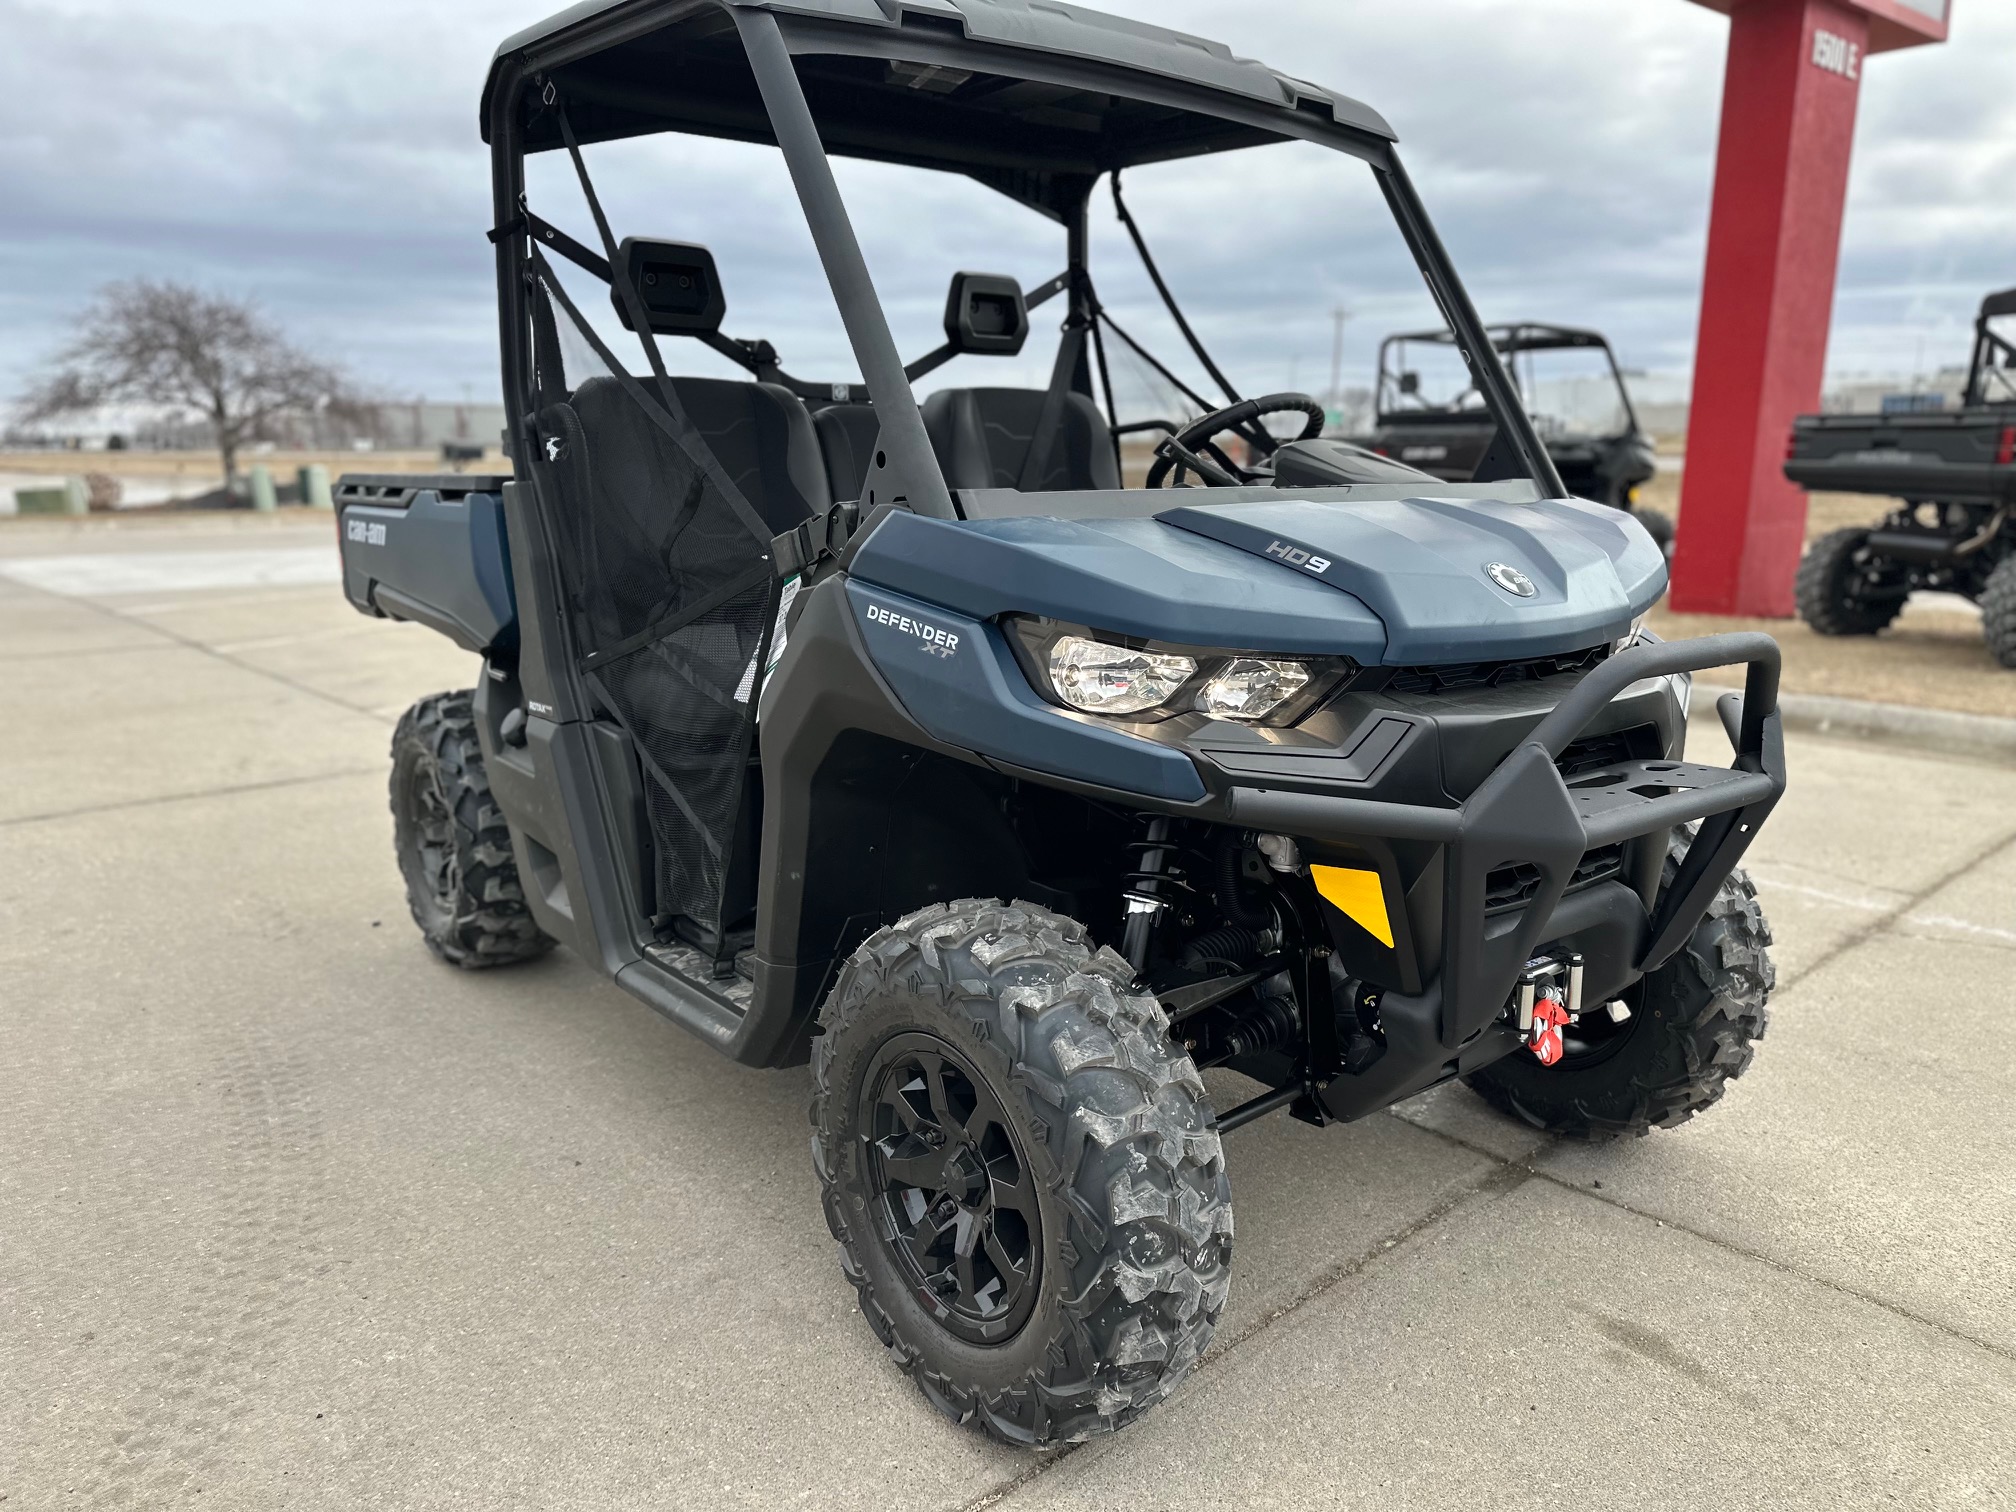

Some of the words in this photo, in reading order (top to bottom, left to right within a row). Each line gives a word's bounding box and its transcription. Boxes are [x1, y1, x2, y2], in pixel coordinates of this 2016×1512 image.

[1846, 43, 1860, 80] E
[1265, 540, 1332, 574] HD9
[866, 604, 959, 650] DEFENDER
[920, 641, 955, 659] XT
